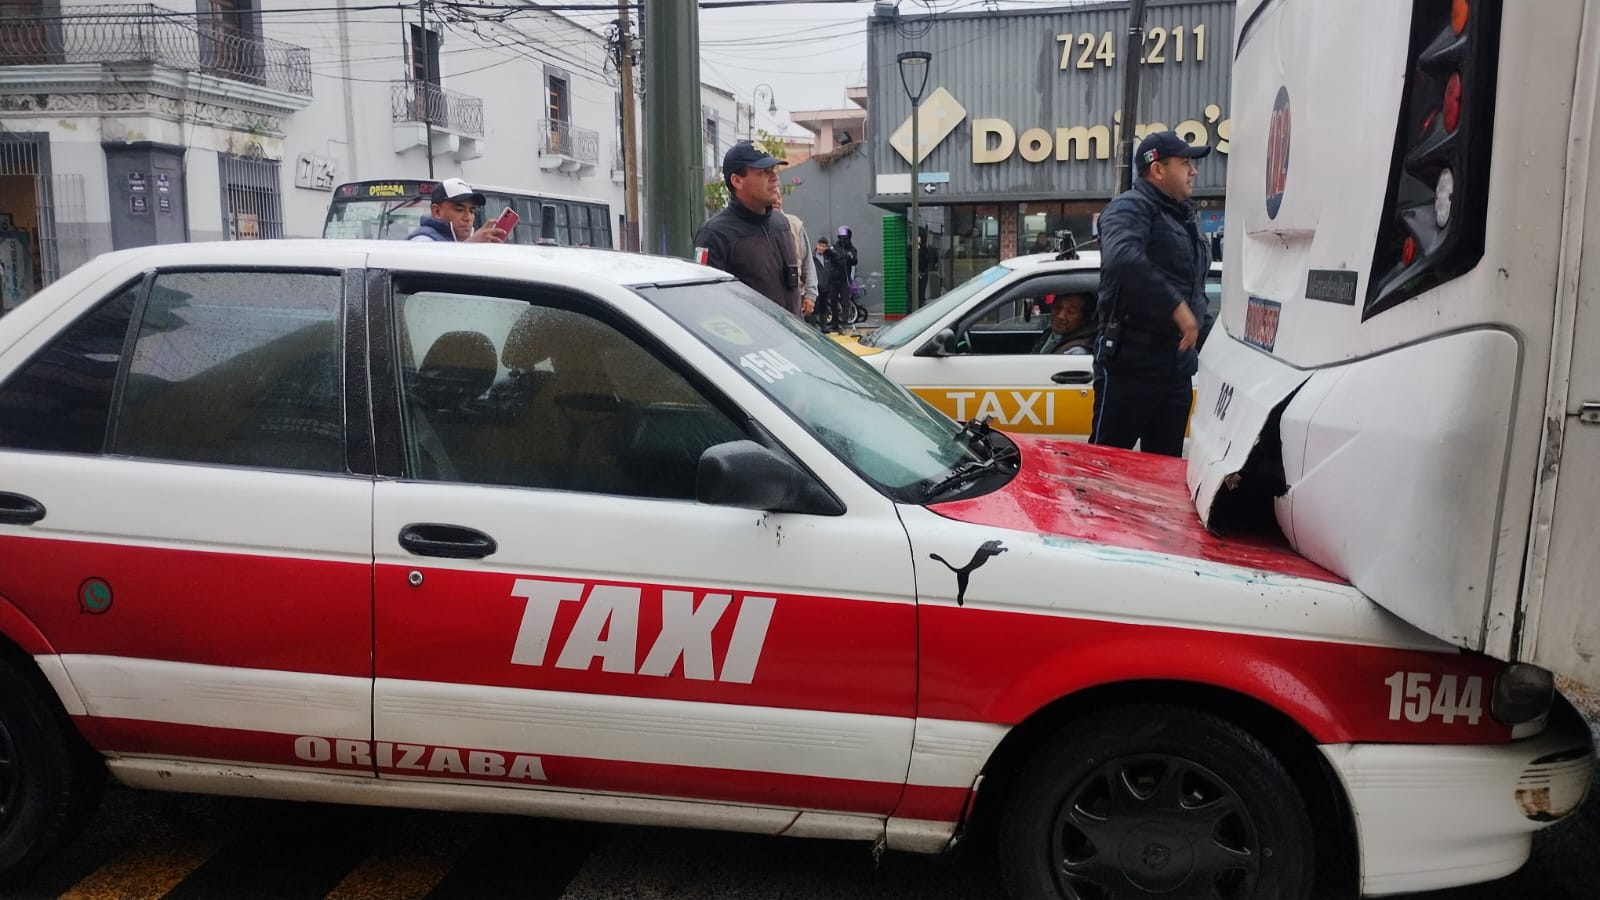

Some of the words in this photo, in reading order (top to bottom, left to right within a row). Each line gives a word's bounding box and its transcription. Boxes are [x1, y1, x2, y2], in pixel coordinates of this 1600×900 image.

[1057, 32, 1115, 69] 724
[369, 184, 404, 196] ORIZABA
[740, 349, 802, 384] 1544
[946, 391, 1055, 426] TAXI
[1213, 382, 1234, 421] 102
[510, 578, 777, 684] TAXI
[1384, 671, 1483, 725] 1544
[294, 736, 547, 781] ORIZABA
